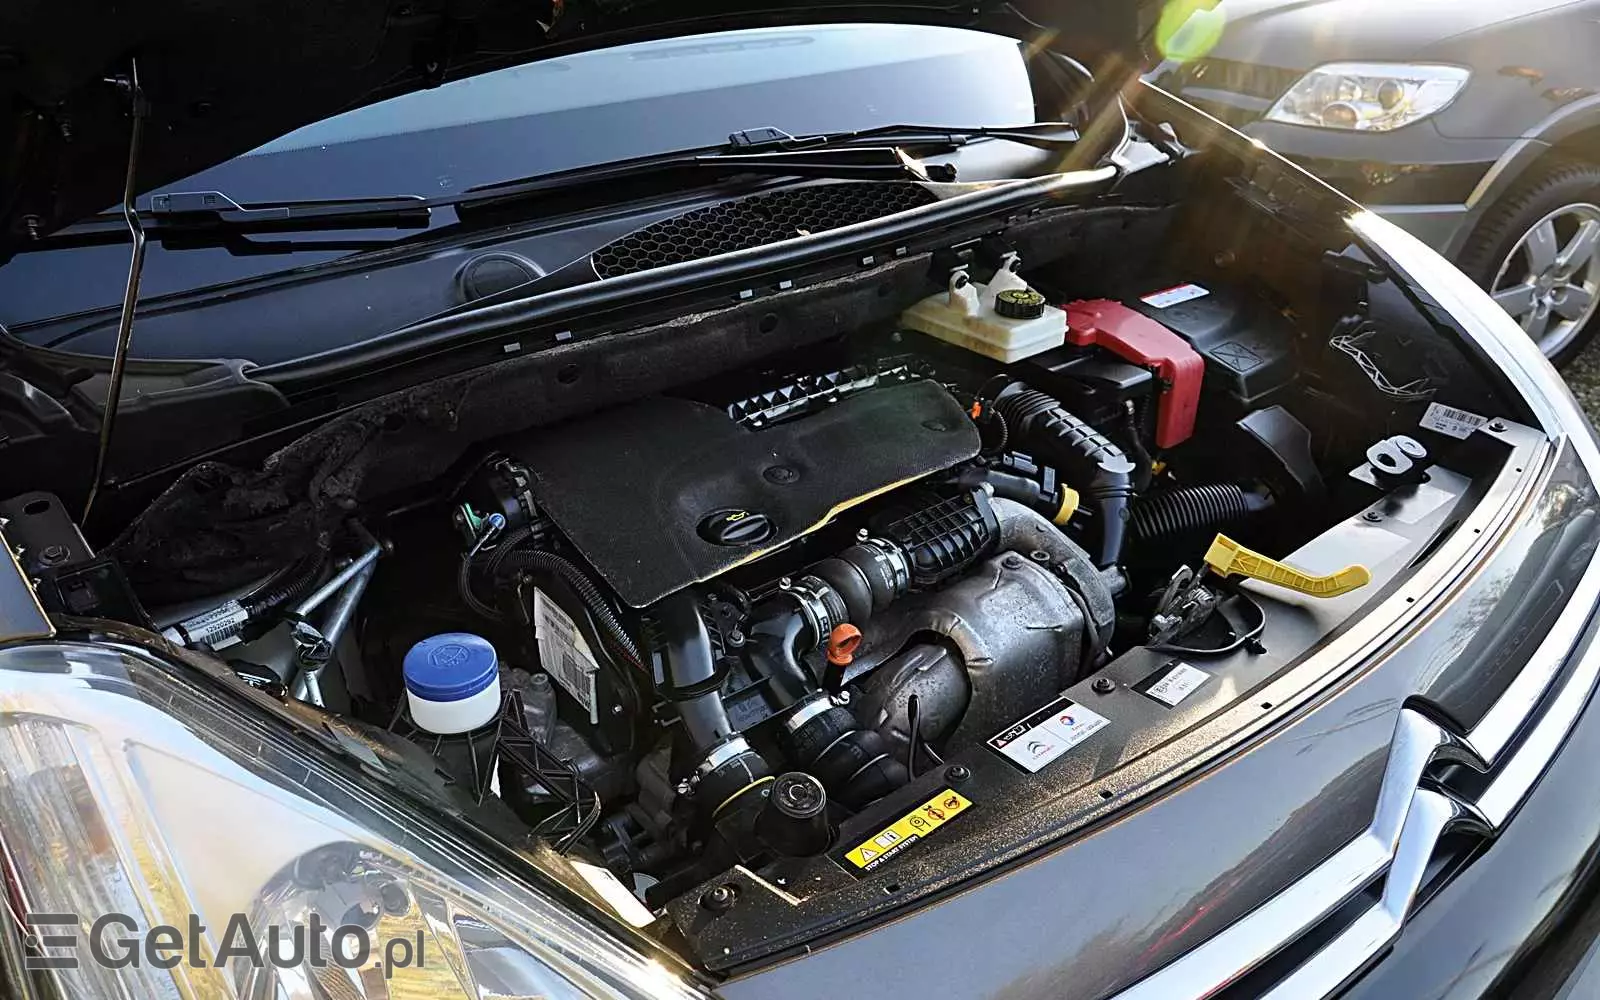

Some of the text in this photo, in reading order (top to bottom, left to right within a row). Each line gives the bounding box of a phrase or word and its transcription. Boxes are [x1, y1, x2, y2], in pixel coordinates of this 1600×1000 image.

[865, 860, 879, 871] STOP
[883, 847, 900, 860] START
[898, 835, 918, 849] SYSTEM
